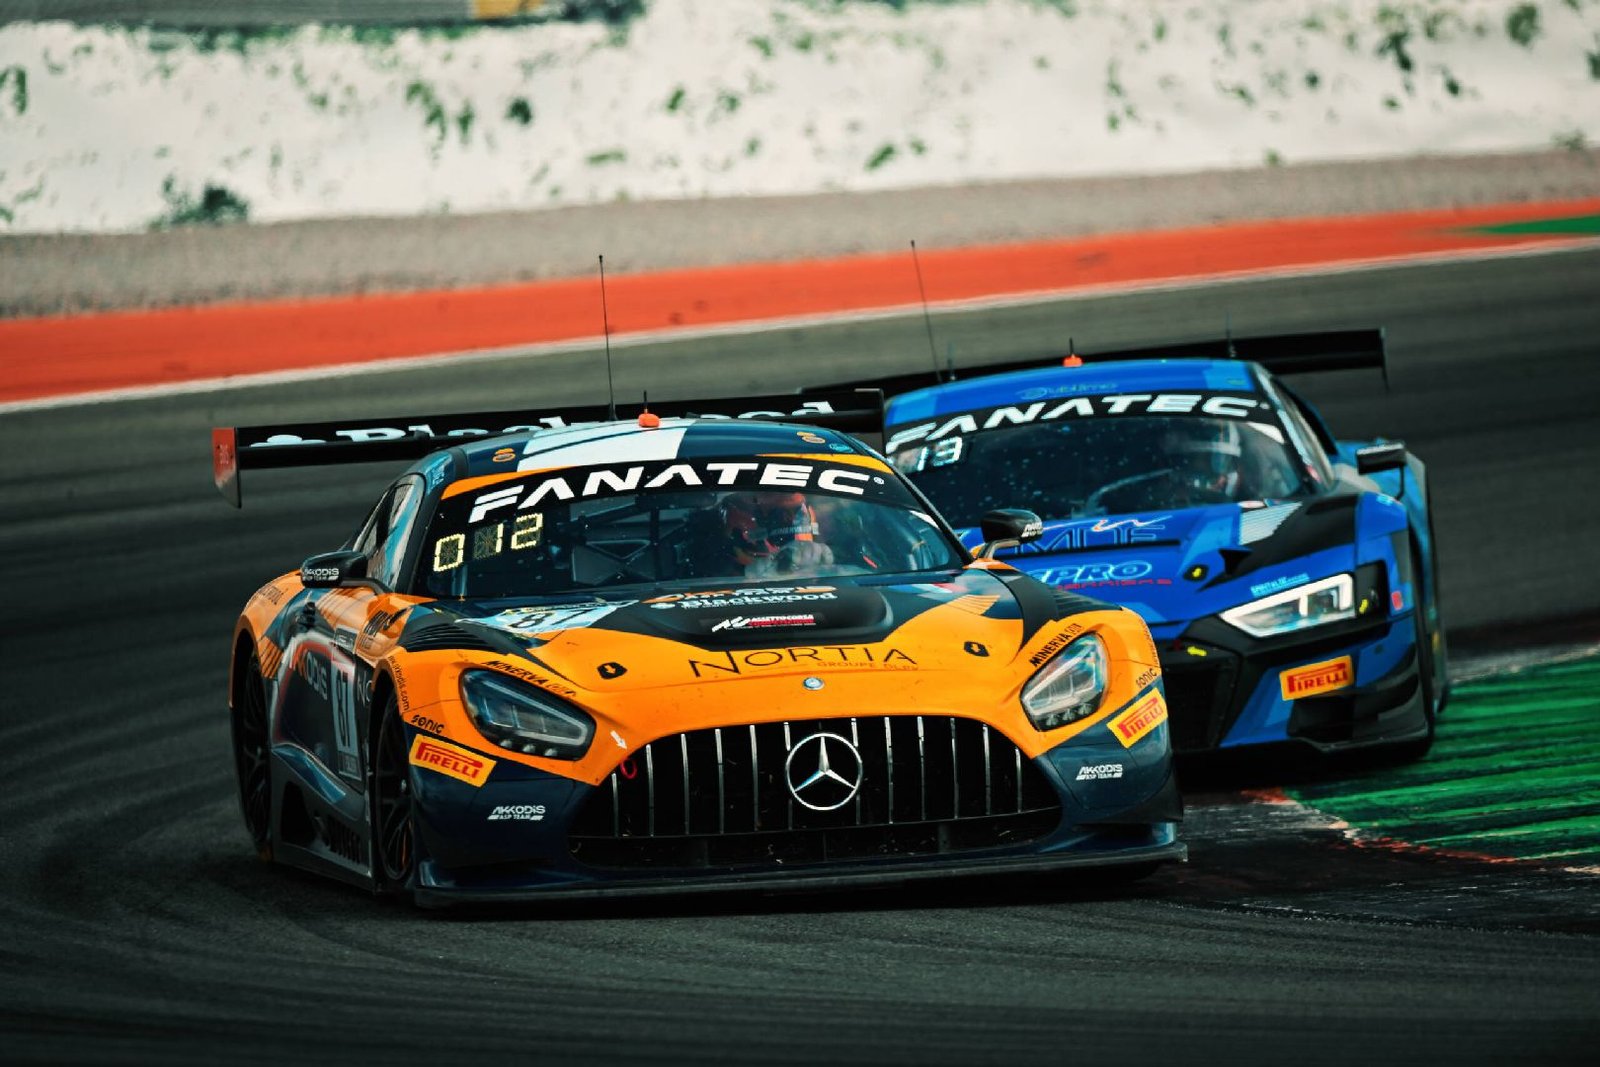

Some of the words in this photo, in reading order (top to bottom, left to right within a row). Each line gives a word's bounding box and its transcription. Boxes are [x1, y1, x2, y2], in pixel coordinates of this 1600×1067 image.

[688, 647, 917, 677] NORTIA
[1286, 662, 1348, 693] PIRELLI
[1117, 697, 1163, 739] PIRELLI
[415, 742, 484, 778] PIRELLI
